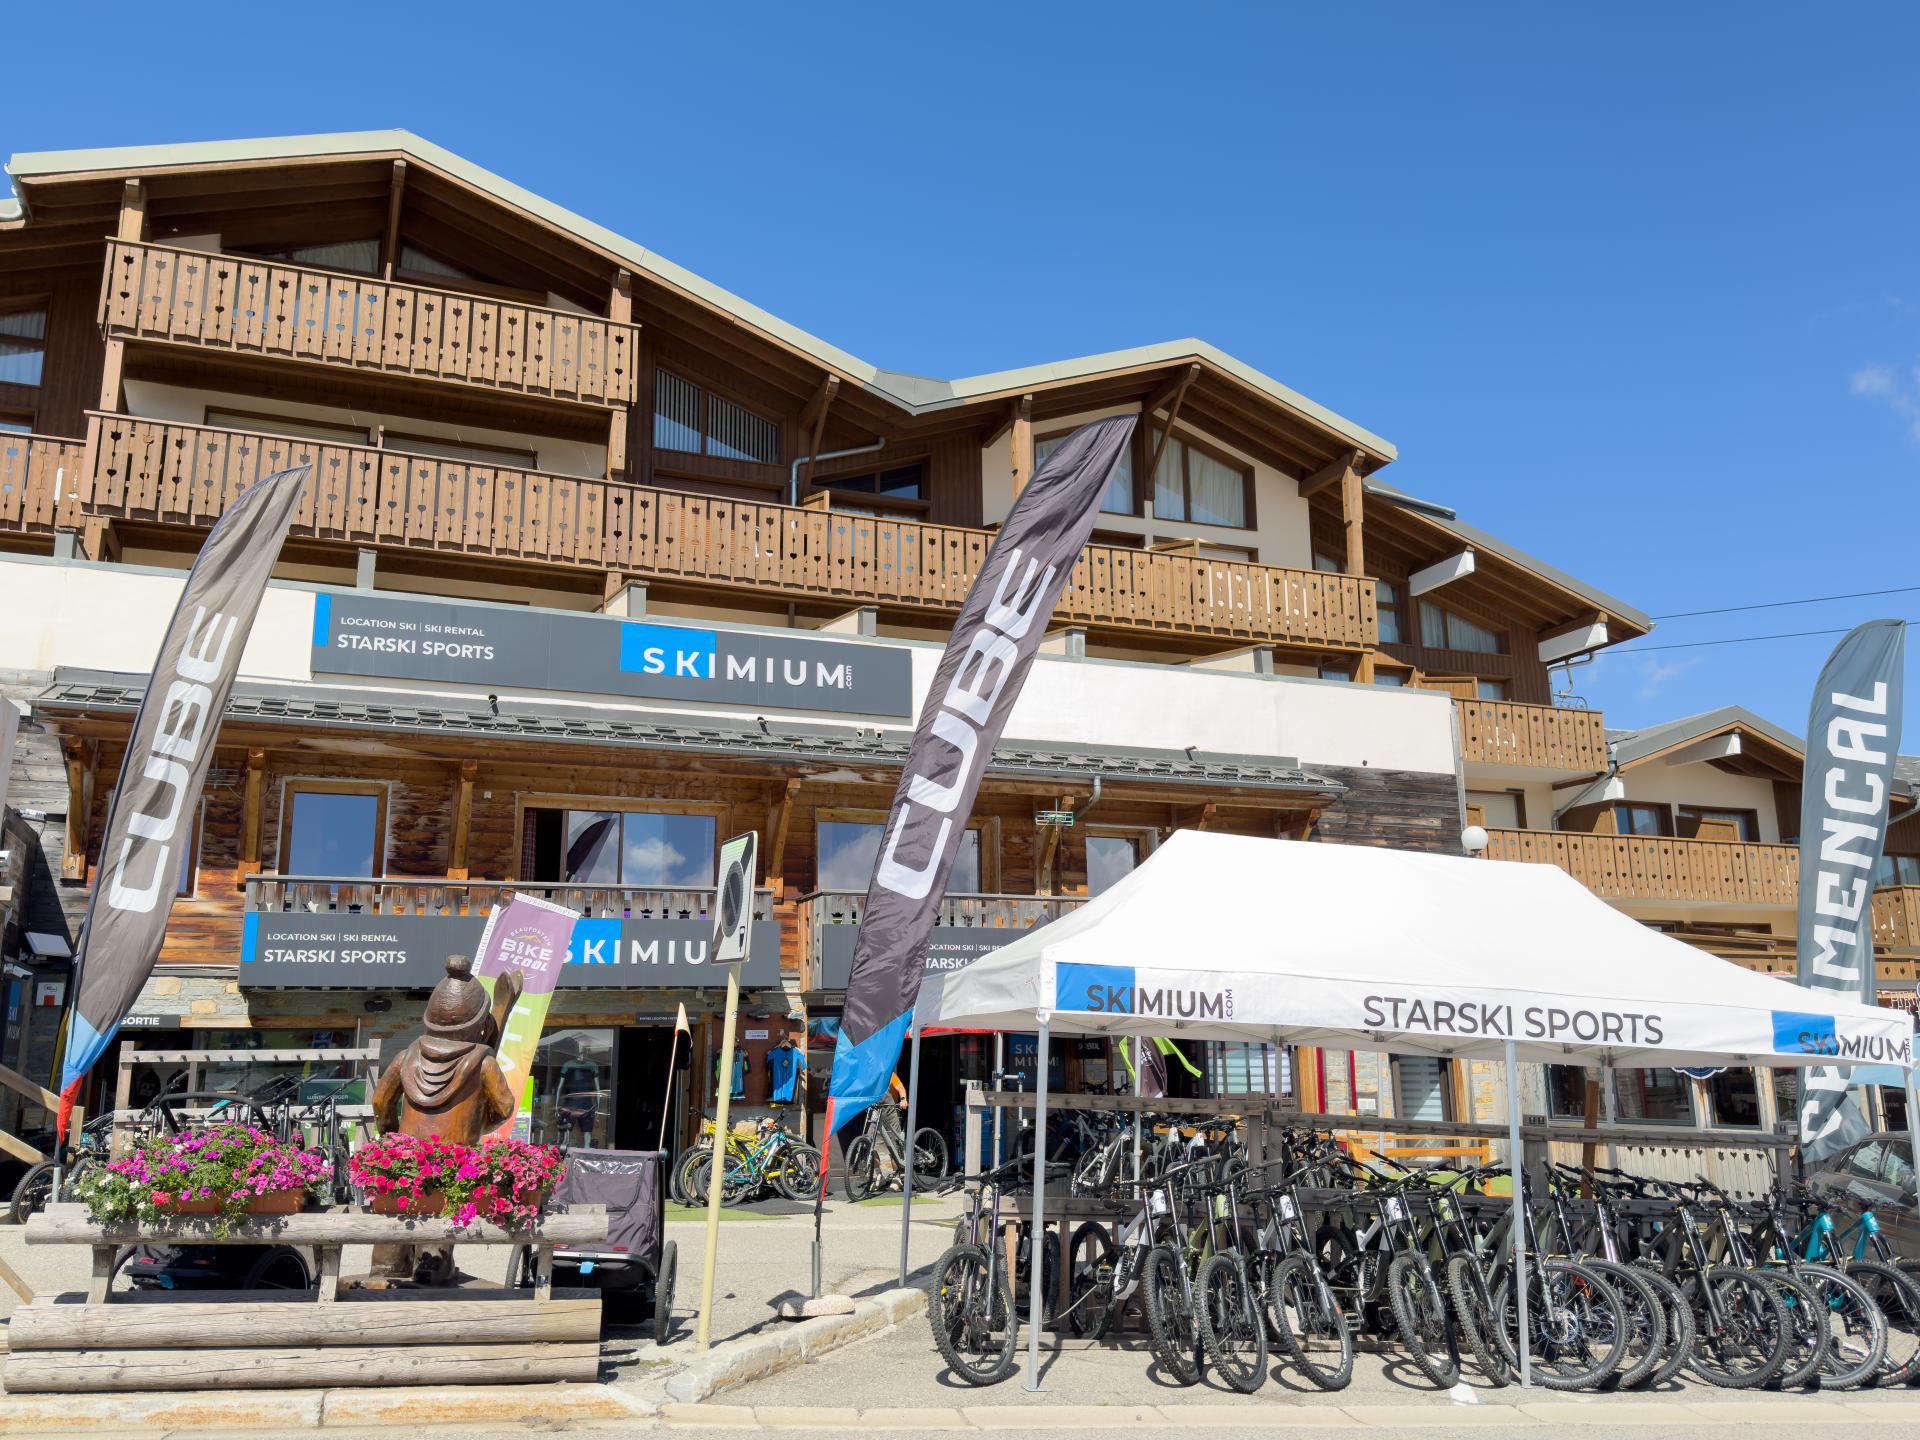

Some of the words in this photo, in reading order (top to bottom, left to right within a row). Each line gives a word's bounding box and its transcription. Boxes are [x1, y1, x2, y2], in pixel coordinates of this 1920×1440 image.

[340, 616, 397, 629] LOCATION
[399, 622, 416, 631] SKI
[424, 624, 442, 633] SKI
[444, 626, 486, 637] RENTAL
[337, 634, 416, 654] STARSKI
[422, 641, 495, 661] SPORTS
[642, 647, 845, 689] SKIMIUM
[876, 548, 1056, 900] CUBE
[108, 606, 238, 913] CUBE
[267, 932, 317, 941] LOCATION
[319, 933, 336, 942] SKI
[343, 934, 359, 942] SKI
[361, 934, 398, 942] RENTAL
[928, 943, 961, 951] OCATION
[264, 949, 335, 963] STARSKI
[340, 950, 407, 964] SPORTS
[498, 951, 548, 972] S'COOL
[562, 939, 707, 965] KIMIU
[925, 957, 968, 969] TARSK
[1086, 984, 1224, 1019] SKIMIUM
[1225, 988, 1233, 1020] .COM
[120, 1016, 160, 1025] SORTIE
[1363, 995, 1513, 1036] STARSKI
[1524, 1007, 1664, 1045] SPORTS
